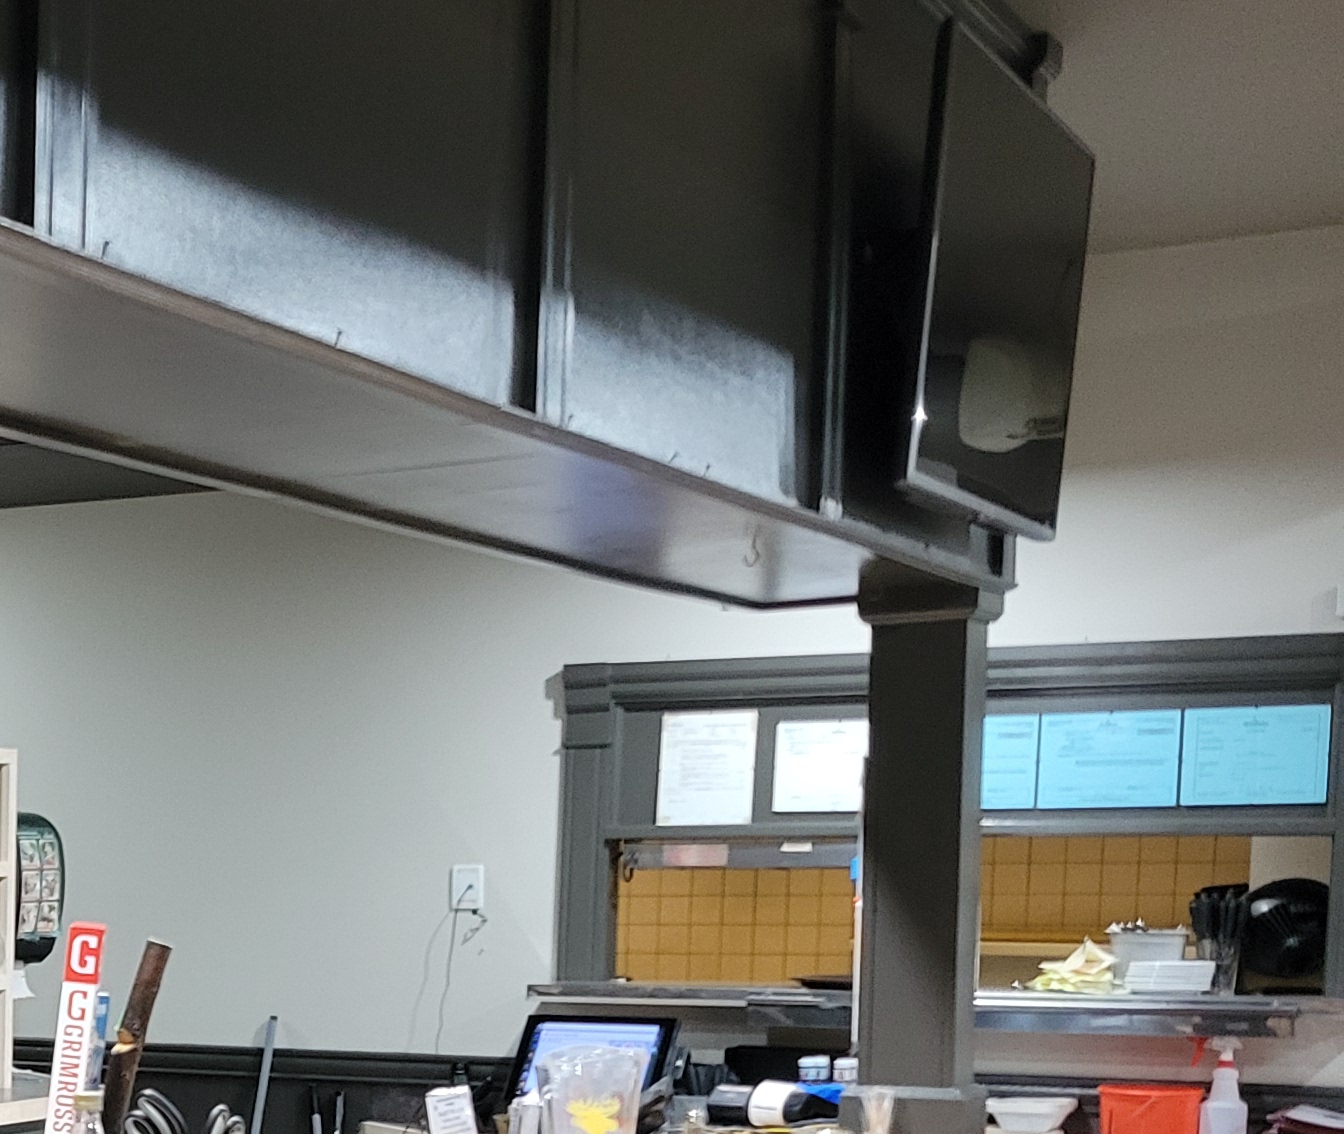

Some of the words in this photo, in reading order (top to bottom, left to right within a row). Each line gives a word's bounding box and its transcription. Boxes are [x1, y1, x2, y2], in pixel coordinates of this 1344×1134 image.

[69, 934, 99, 975] G
[67, 990, 88, 1021] G
[53, 1024, 84, 1133] GRIMROSS
